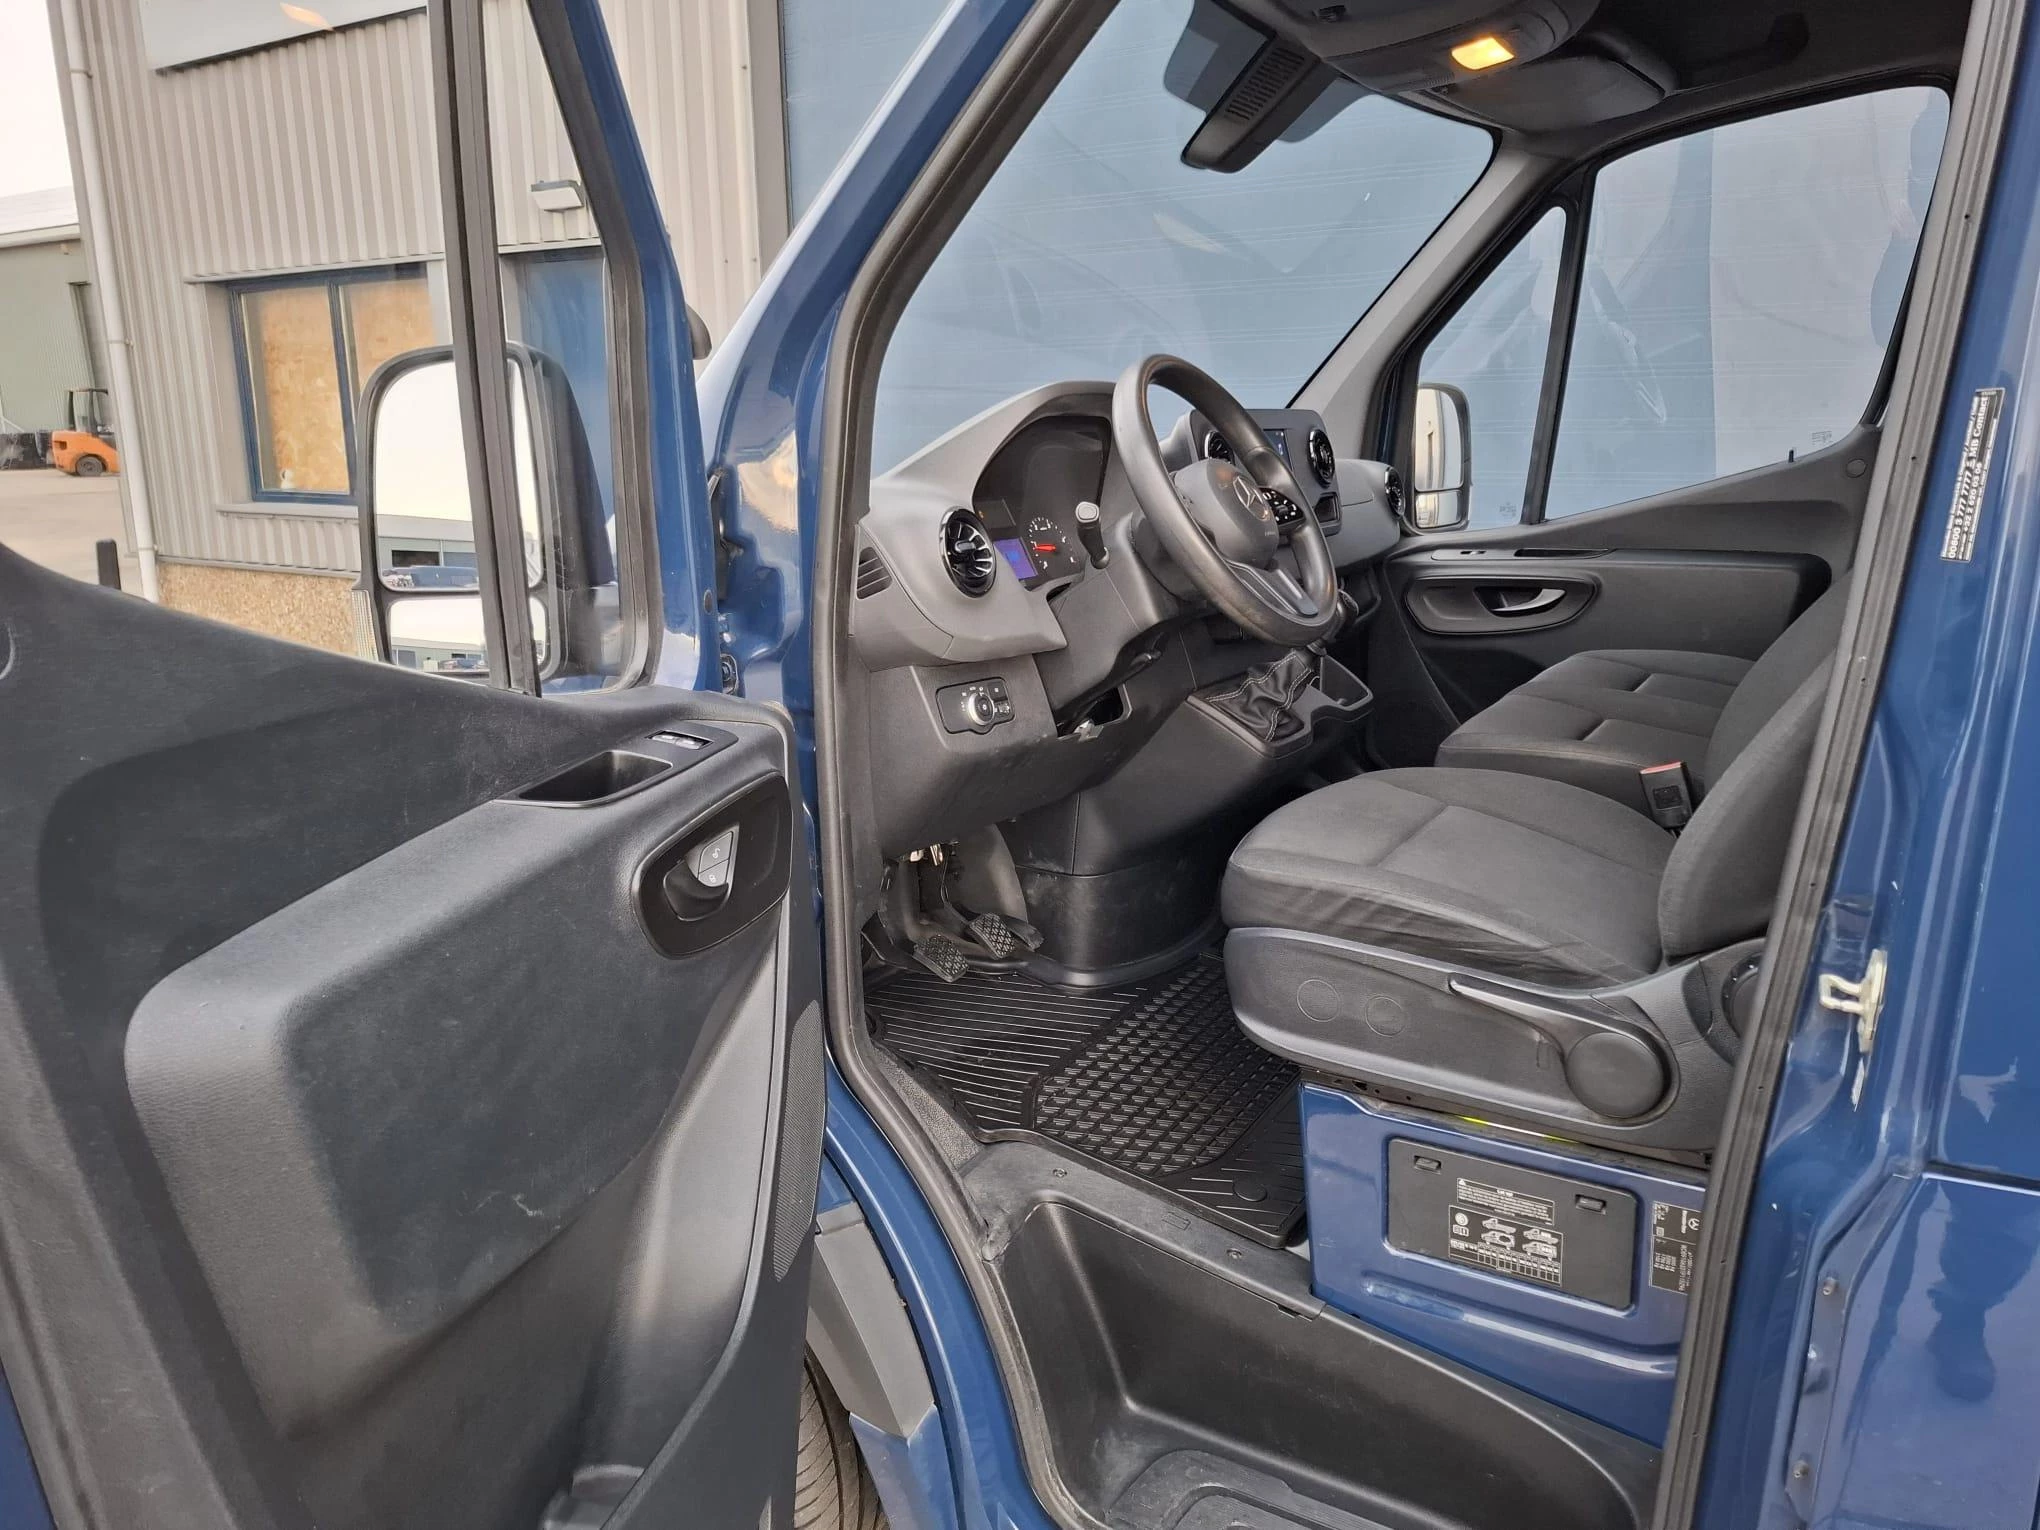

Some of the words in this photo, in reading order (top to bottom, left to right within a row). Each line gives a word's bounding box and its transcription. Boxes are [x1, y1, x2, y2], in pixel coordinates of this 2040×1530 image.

[1973, 396, 1989, 437] Contact
[1968, 439, 1979, 457] MB
[1961, 469, 1972, 496] 7777
[1957, 497, 1967, 517] 777
[1955, 518, 1963, 526] 3
